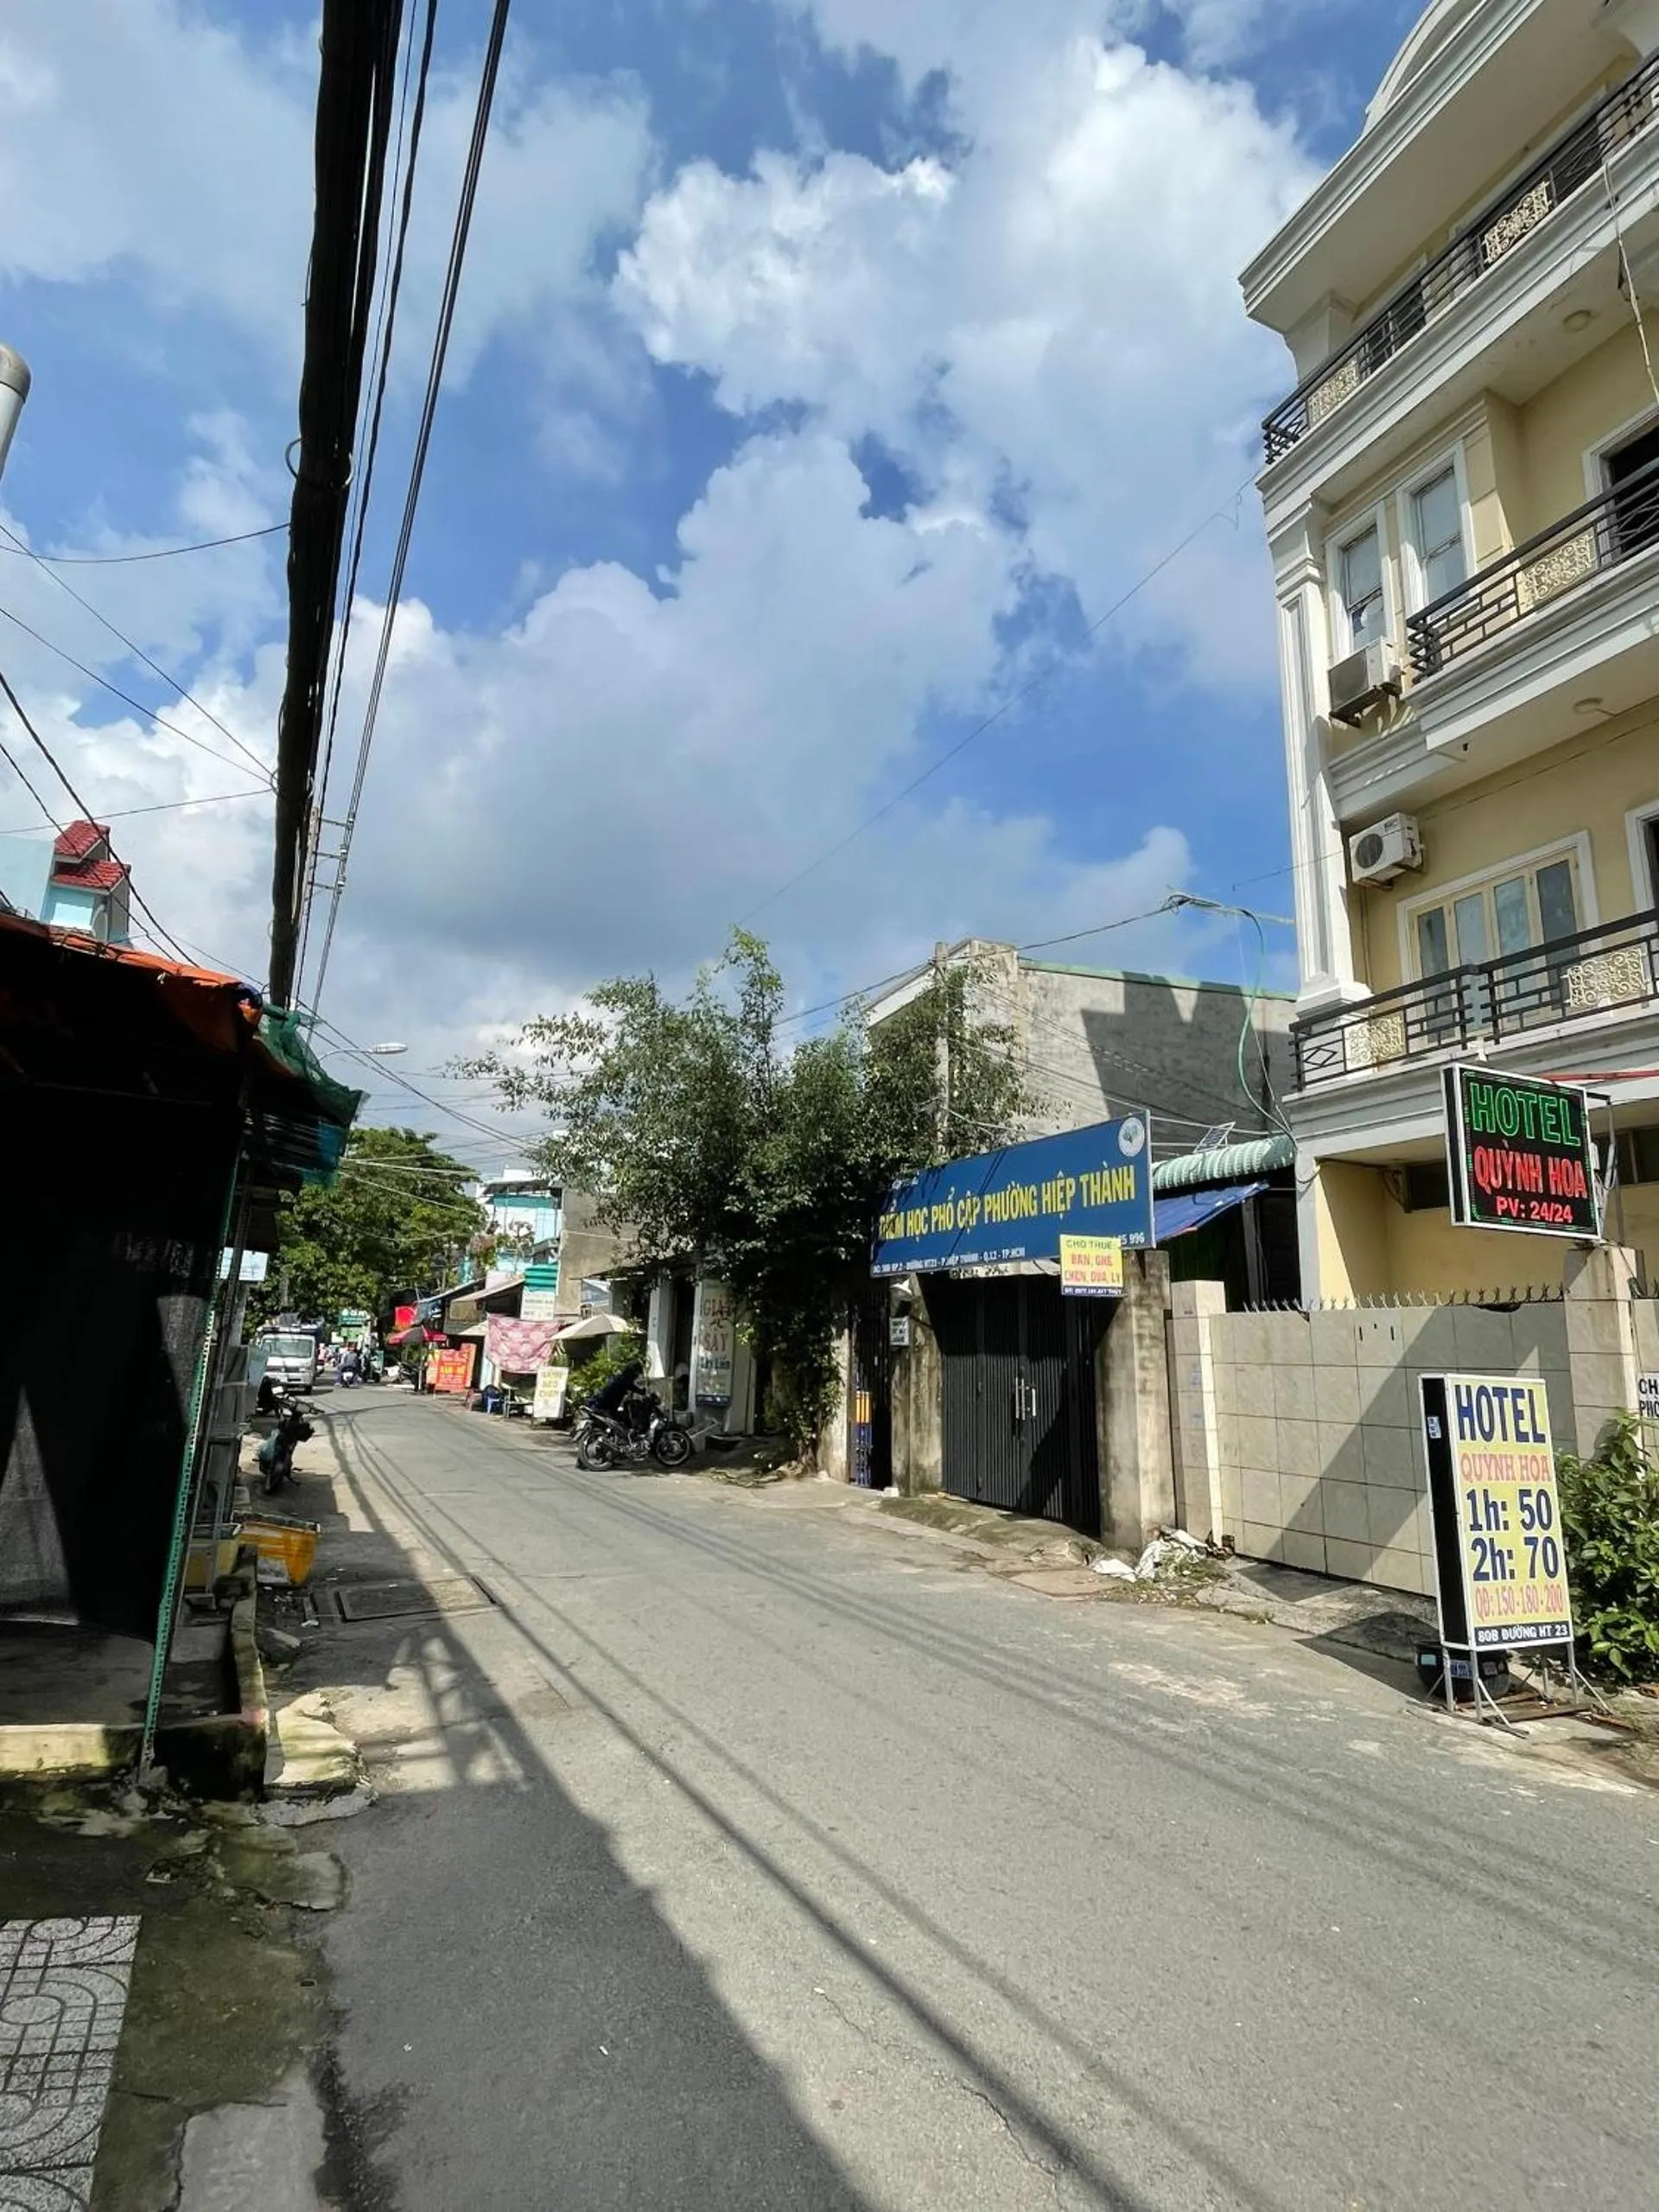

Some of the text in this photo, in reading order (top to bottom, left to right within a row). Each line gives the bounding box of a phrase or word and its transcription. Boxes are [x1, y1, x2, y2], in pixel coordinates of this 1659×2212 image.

[1470, 1082, 1581, 1147] HOTEL
[1473, 1138, 1588, 1199] QUỲNH HOA
[906, 1205, 929, 1243] HỌC
[931, 1185, 955, 1233] PHỔ
[957, 1190, 982, 1235] CẬP
[984, 1180, 1038, 1224] PHƯỜNG
[1041, 1169, 1076, 1220] HIỆP
[1079, 1160, 1135, 1208] THÀNH
[1496, 1195, 1573, 1224] PV: 24/24
[1454, 1384, 1547, 1444] HOTEL
[1518, 1453, 1553, 1482] HOA
[1466, 1488, 1553, 1532] 1h: 50
[1471, 1535, 1559, 1582] 2h: 70
[1501, 1624, 1537, 1641] ĐƯỜNG
[1538, 1624, 1553, 1638] HT
[1554, 1624, 1568, 1637] 23
